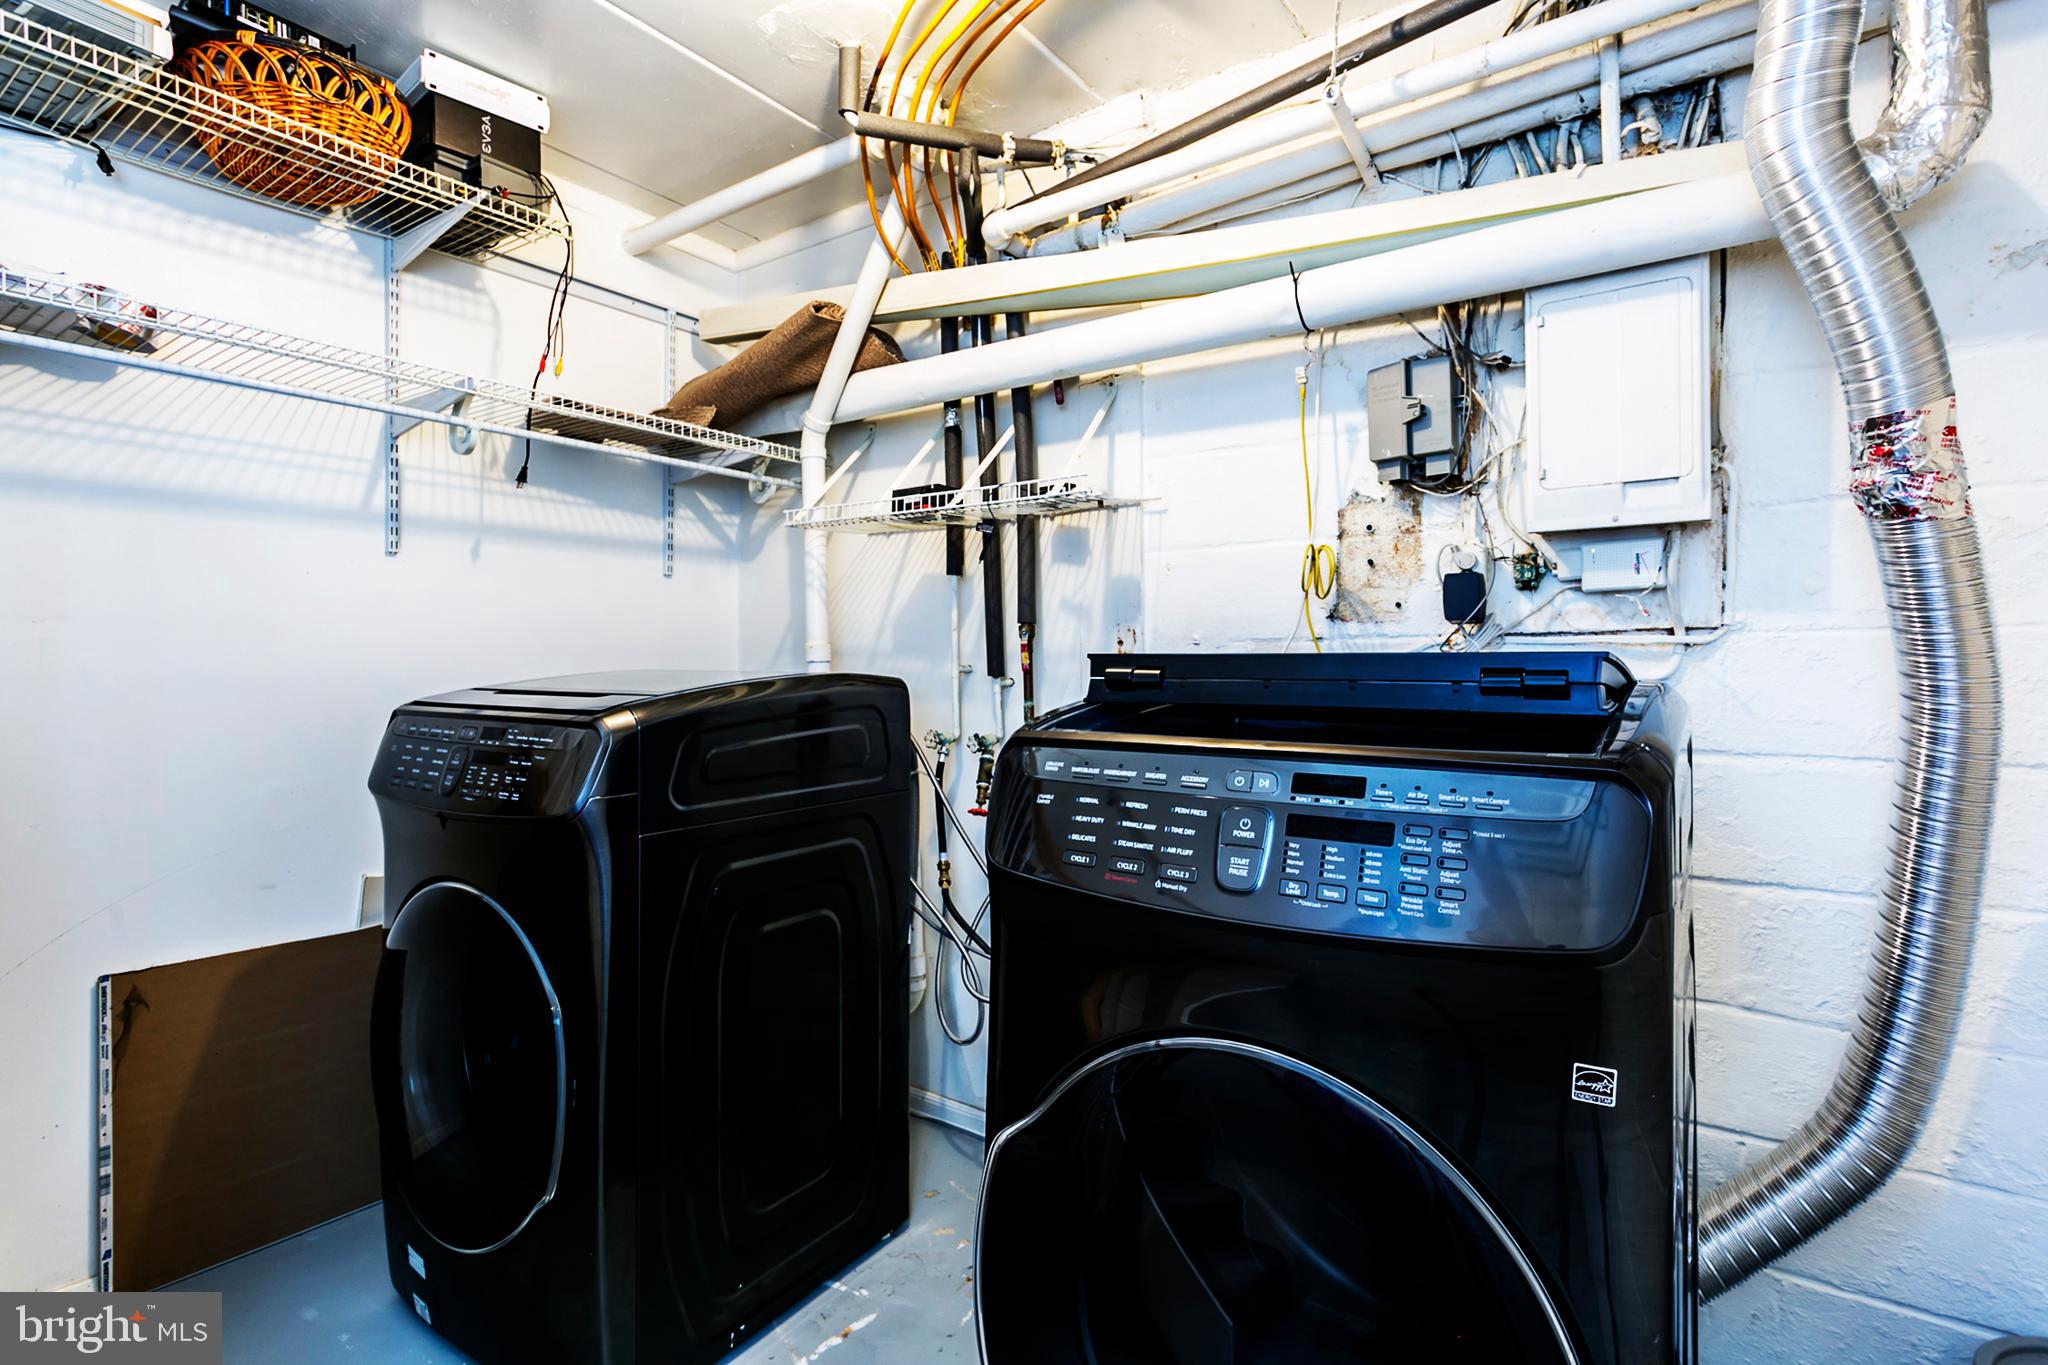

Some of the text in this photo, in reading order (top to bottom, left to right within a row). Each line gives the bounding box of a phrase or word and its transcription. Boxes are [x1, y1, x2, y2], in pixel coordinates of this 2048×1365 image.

[481, 115, 491, 154] EVGA
[1145, 772, 1167, 780] SWEATER
[1181, 775, 1209, 783] ACCESSORY
[1438, 793, 1456, 801] Smart
[1471, 796, 1510, 805] Smart Control
[1126, 801, 1149, 810] REFRESH
[1174, 807, 1208, 818] PERM PRESS
[1075, 815, 1104, 824] HEAVY DUTY
[1122, 820, 1157, 831] WRINKLE AWAY
[1171, 826, 1196, 836] TIME DRY
[1232, 829, 1255, 839] POWER
[1071, 833, 1096, 843] DELICATES
[1117, 839, 1154, 851] STEAM SANITIZE
[1442, 841, 1461, 849] Adjust
[1167, 847, 1194, 857] AIR FLUFF
[1070, 854, 1086, 863] CYCLE
[1230, 856, 1250, 866] START
[1325, 854, 1345, 862] Medium
[1116, 861, 1133, 870] CYCLE
[1167, 868, 1190, 879] CYCLE 3
[1228, 868, 1249, 877] PAUSE
[1412, 867, 1429, 875] Static
[1440, 870, 1459, 878] Adjust
[1161, 881, 1188, 893] Manual Dry
[1285, 887, 1301, 895] Level
[1323, 889, 1340, 898] Temp.
[1363, 894, 1379, 903] Time
[1401, 896, 1423, 904] Wrinkle
[1401, 902, 1423, 910] Prevent
[1437, 907, 1460, 915] Control
